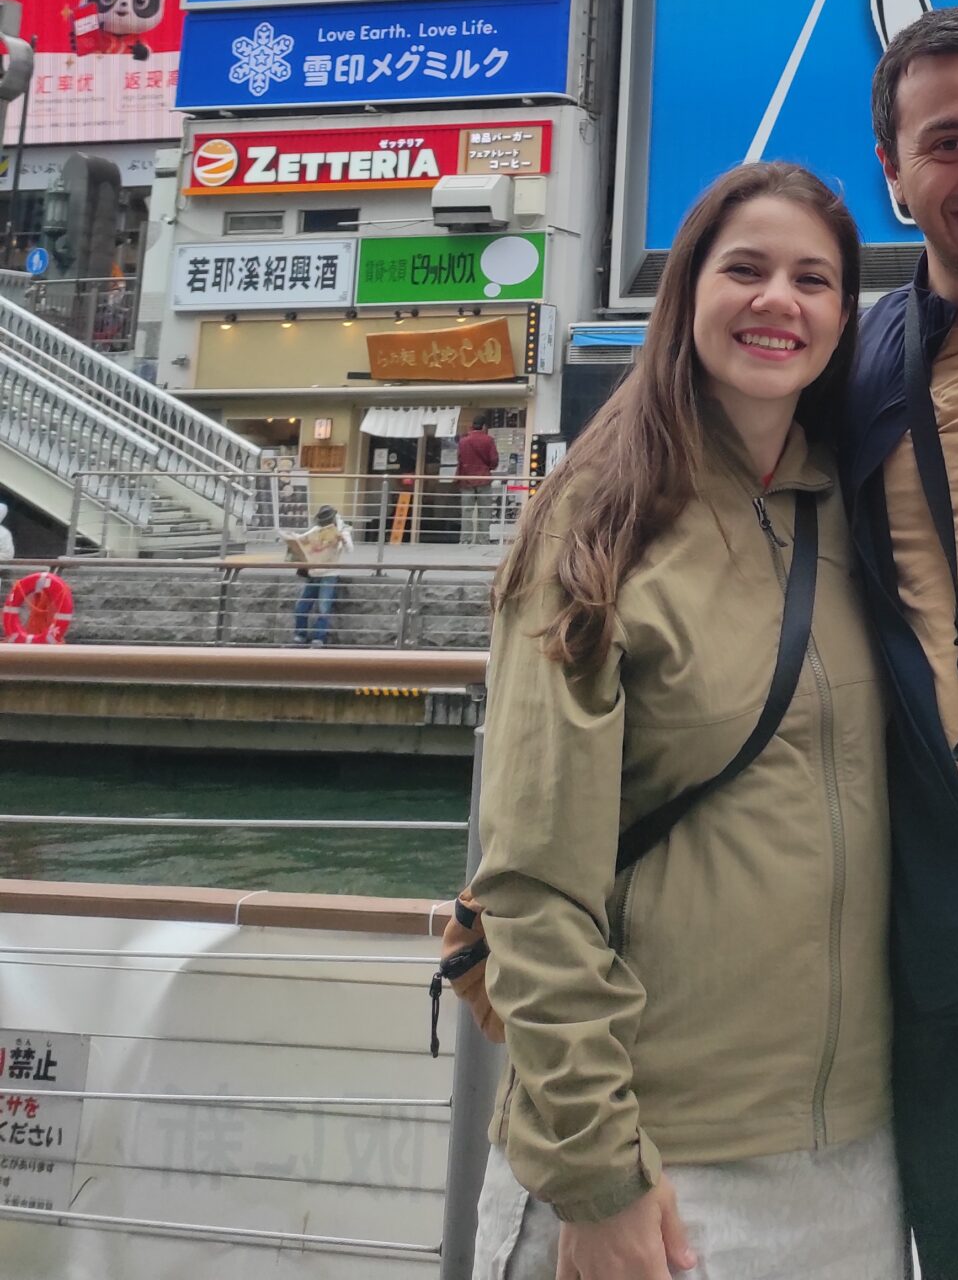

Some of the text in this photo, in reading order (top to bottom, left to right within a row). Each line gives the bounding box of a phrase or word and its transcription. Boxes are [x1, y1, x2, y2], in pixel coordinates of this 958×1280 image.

[318, 19, 498, 43] Love Earth. Love Life.
[303, 45, 509, 87] 雪印メグミルク
[378, 138, 424, 149] ゼッテリア
[470, 131, 533, 144] 絶品バーガー
[244, 146, 440, 184] ZETTERIA
[469, 149, 519, 158] フェアトレード
[489, 158, 531, 169] コーヒー
[411, 253, 476, 286] ピタットハウス
[0, 1047, 57, 1081] 禁止
